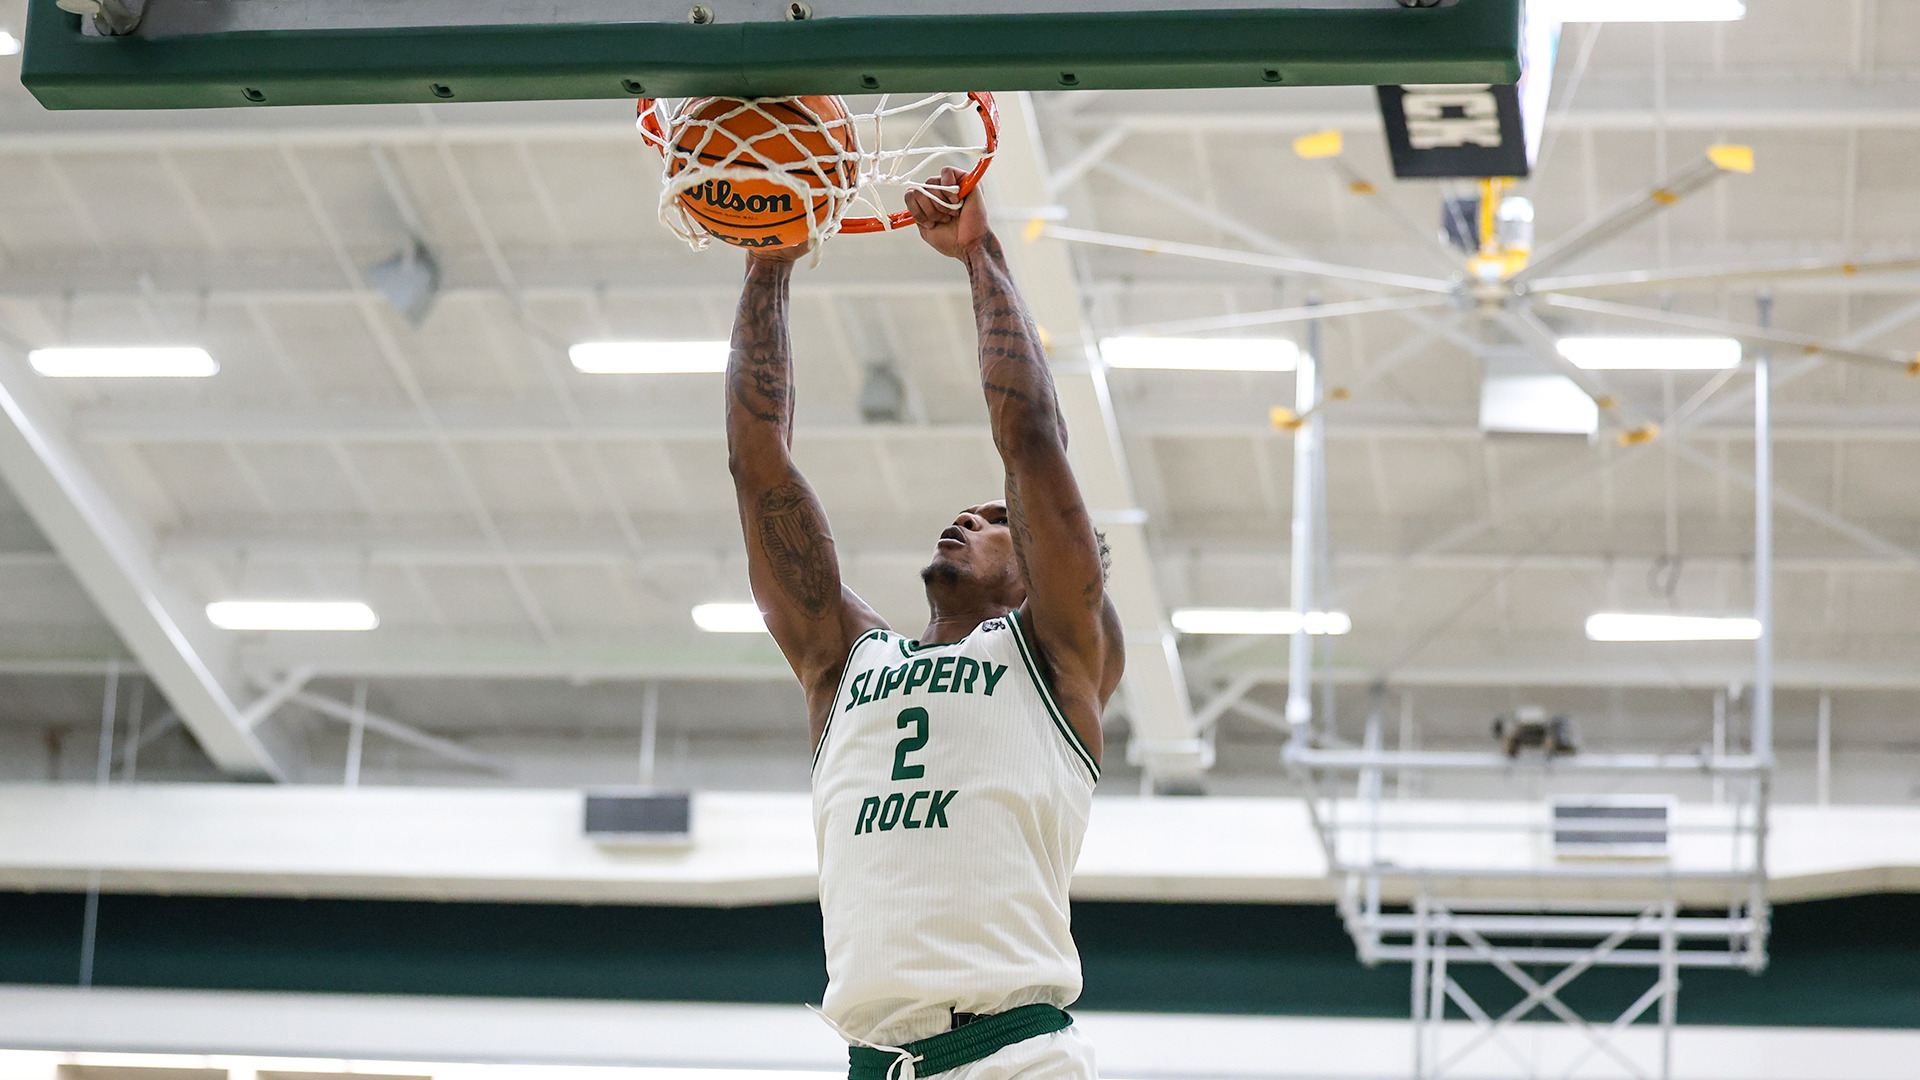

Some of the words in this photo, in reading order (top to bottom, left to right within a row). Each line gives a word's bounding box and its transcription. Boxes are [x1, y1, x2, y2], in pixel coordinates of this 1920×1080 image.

[1400, 84, 1502, 149] CK
[845, 656, 1009, 713] SLIPPERY
[891, 706, 930, 781] 2
[854, 790, 959, 836] ROCK
